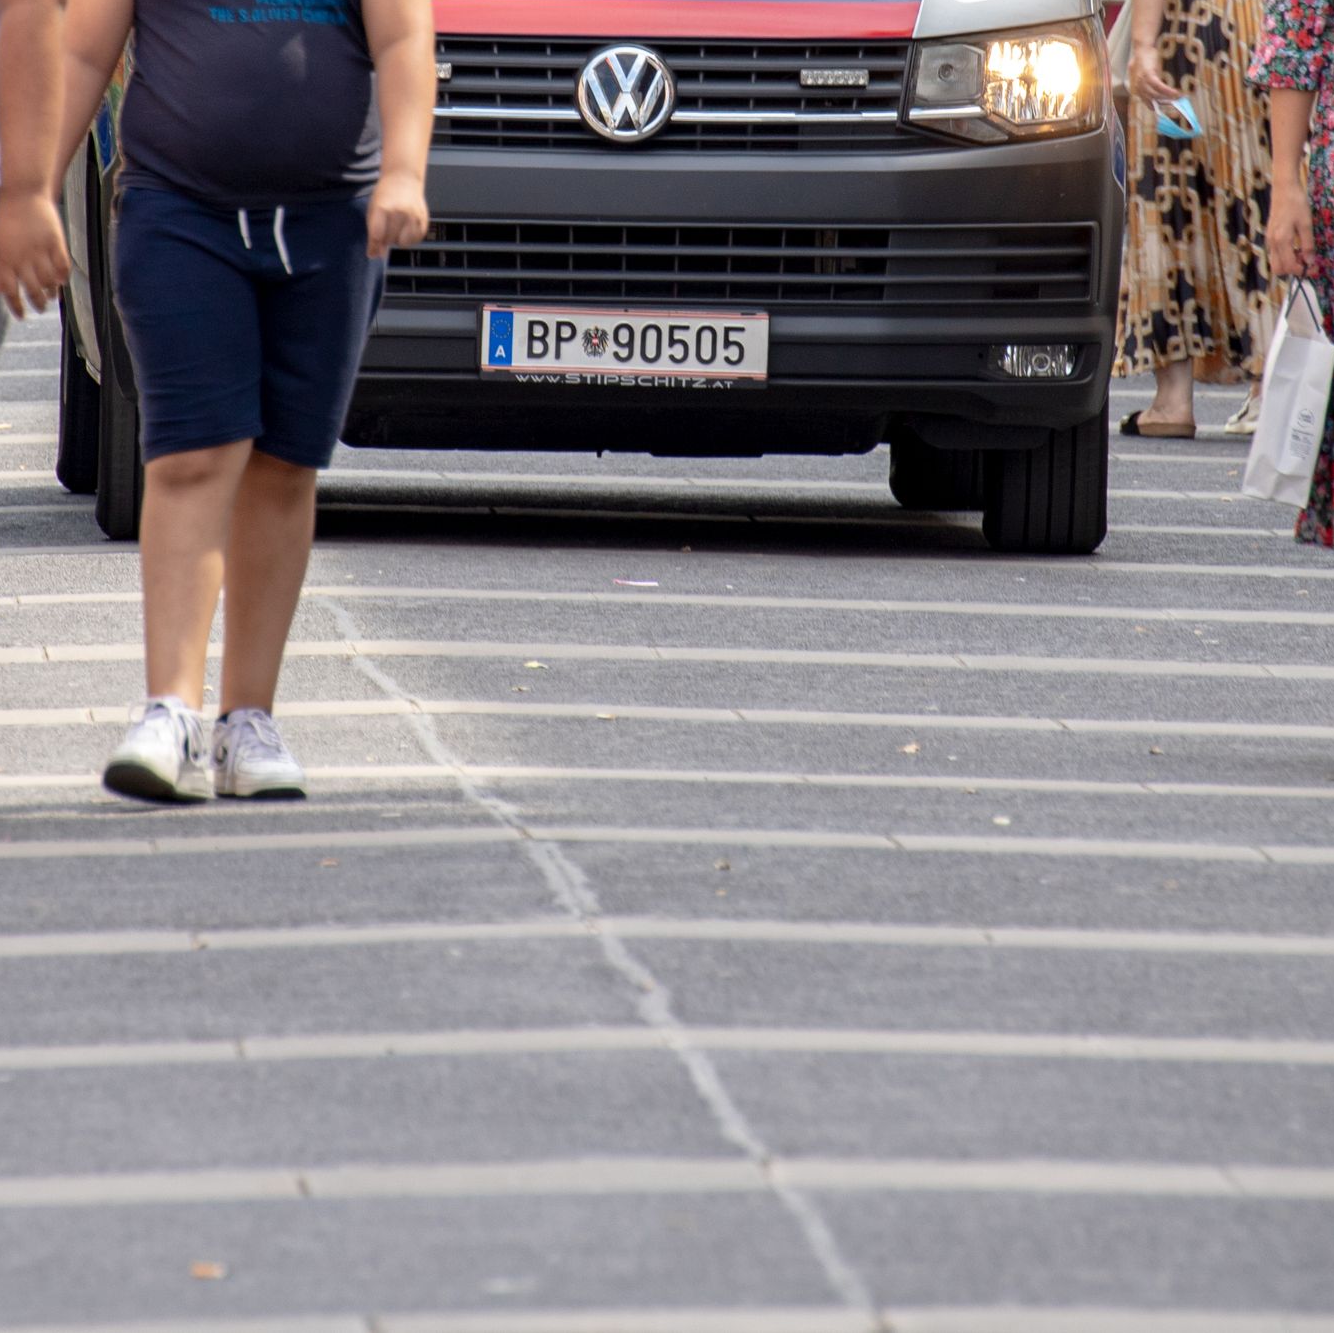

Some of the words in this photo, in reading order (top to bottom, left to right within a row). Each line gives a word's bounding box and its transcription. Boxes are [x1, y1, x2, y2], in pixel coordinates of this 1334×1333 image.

[495, 345, 506, 358] A
[527, 319, 577, 360] BP
[612, 322, 746, 366] 90505
